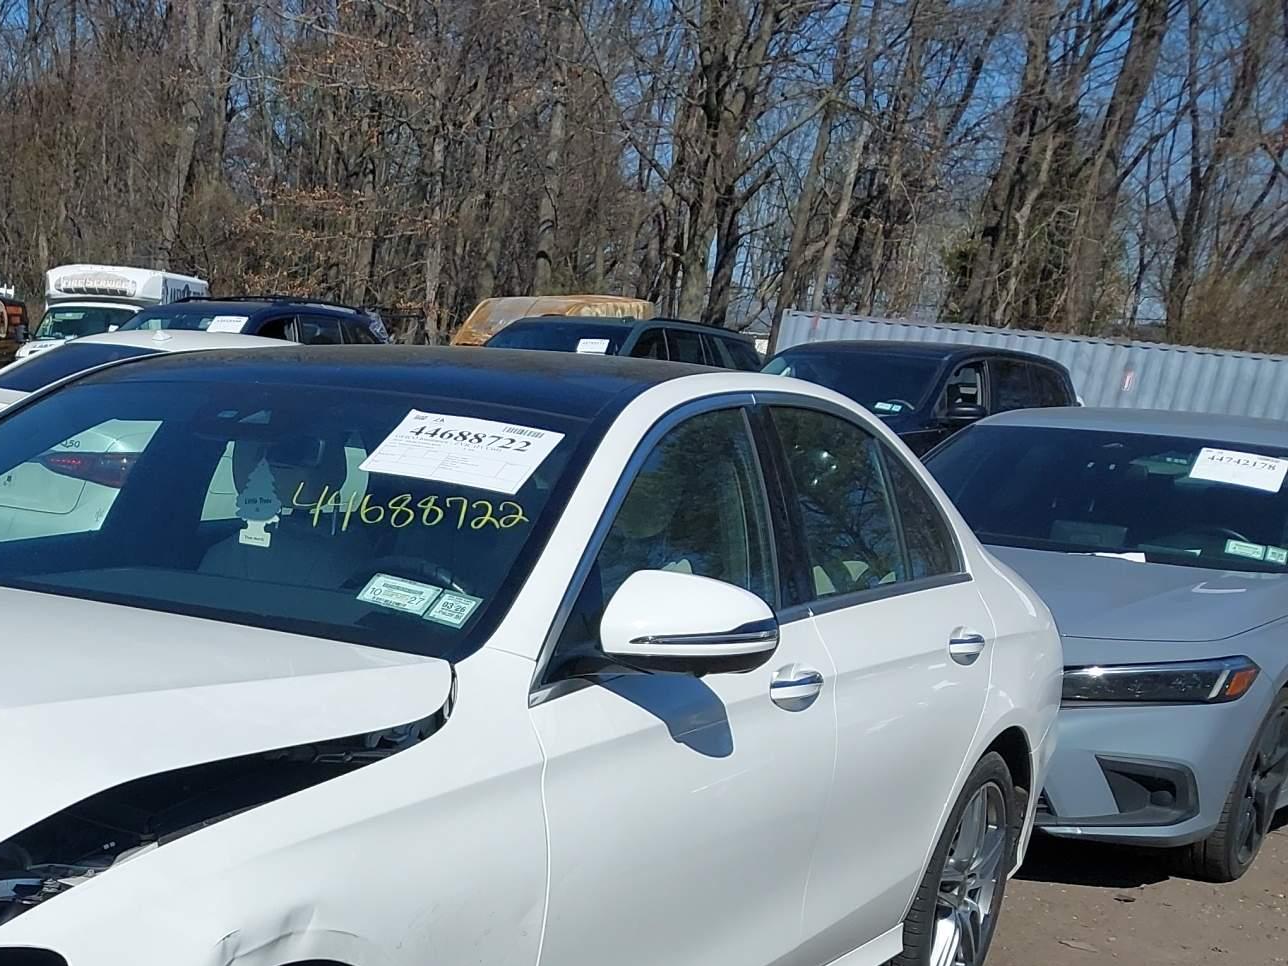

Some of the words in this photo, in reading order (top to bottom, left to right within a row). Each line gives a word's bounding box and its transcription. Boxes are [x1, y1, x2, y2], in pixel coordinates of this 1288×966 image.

[409, 425, 531, 452] 44688722
[292, 482, 530, 536] 44688722
[369, 587, 382, 596] 10
[407, 596, 424, 606] 27
